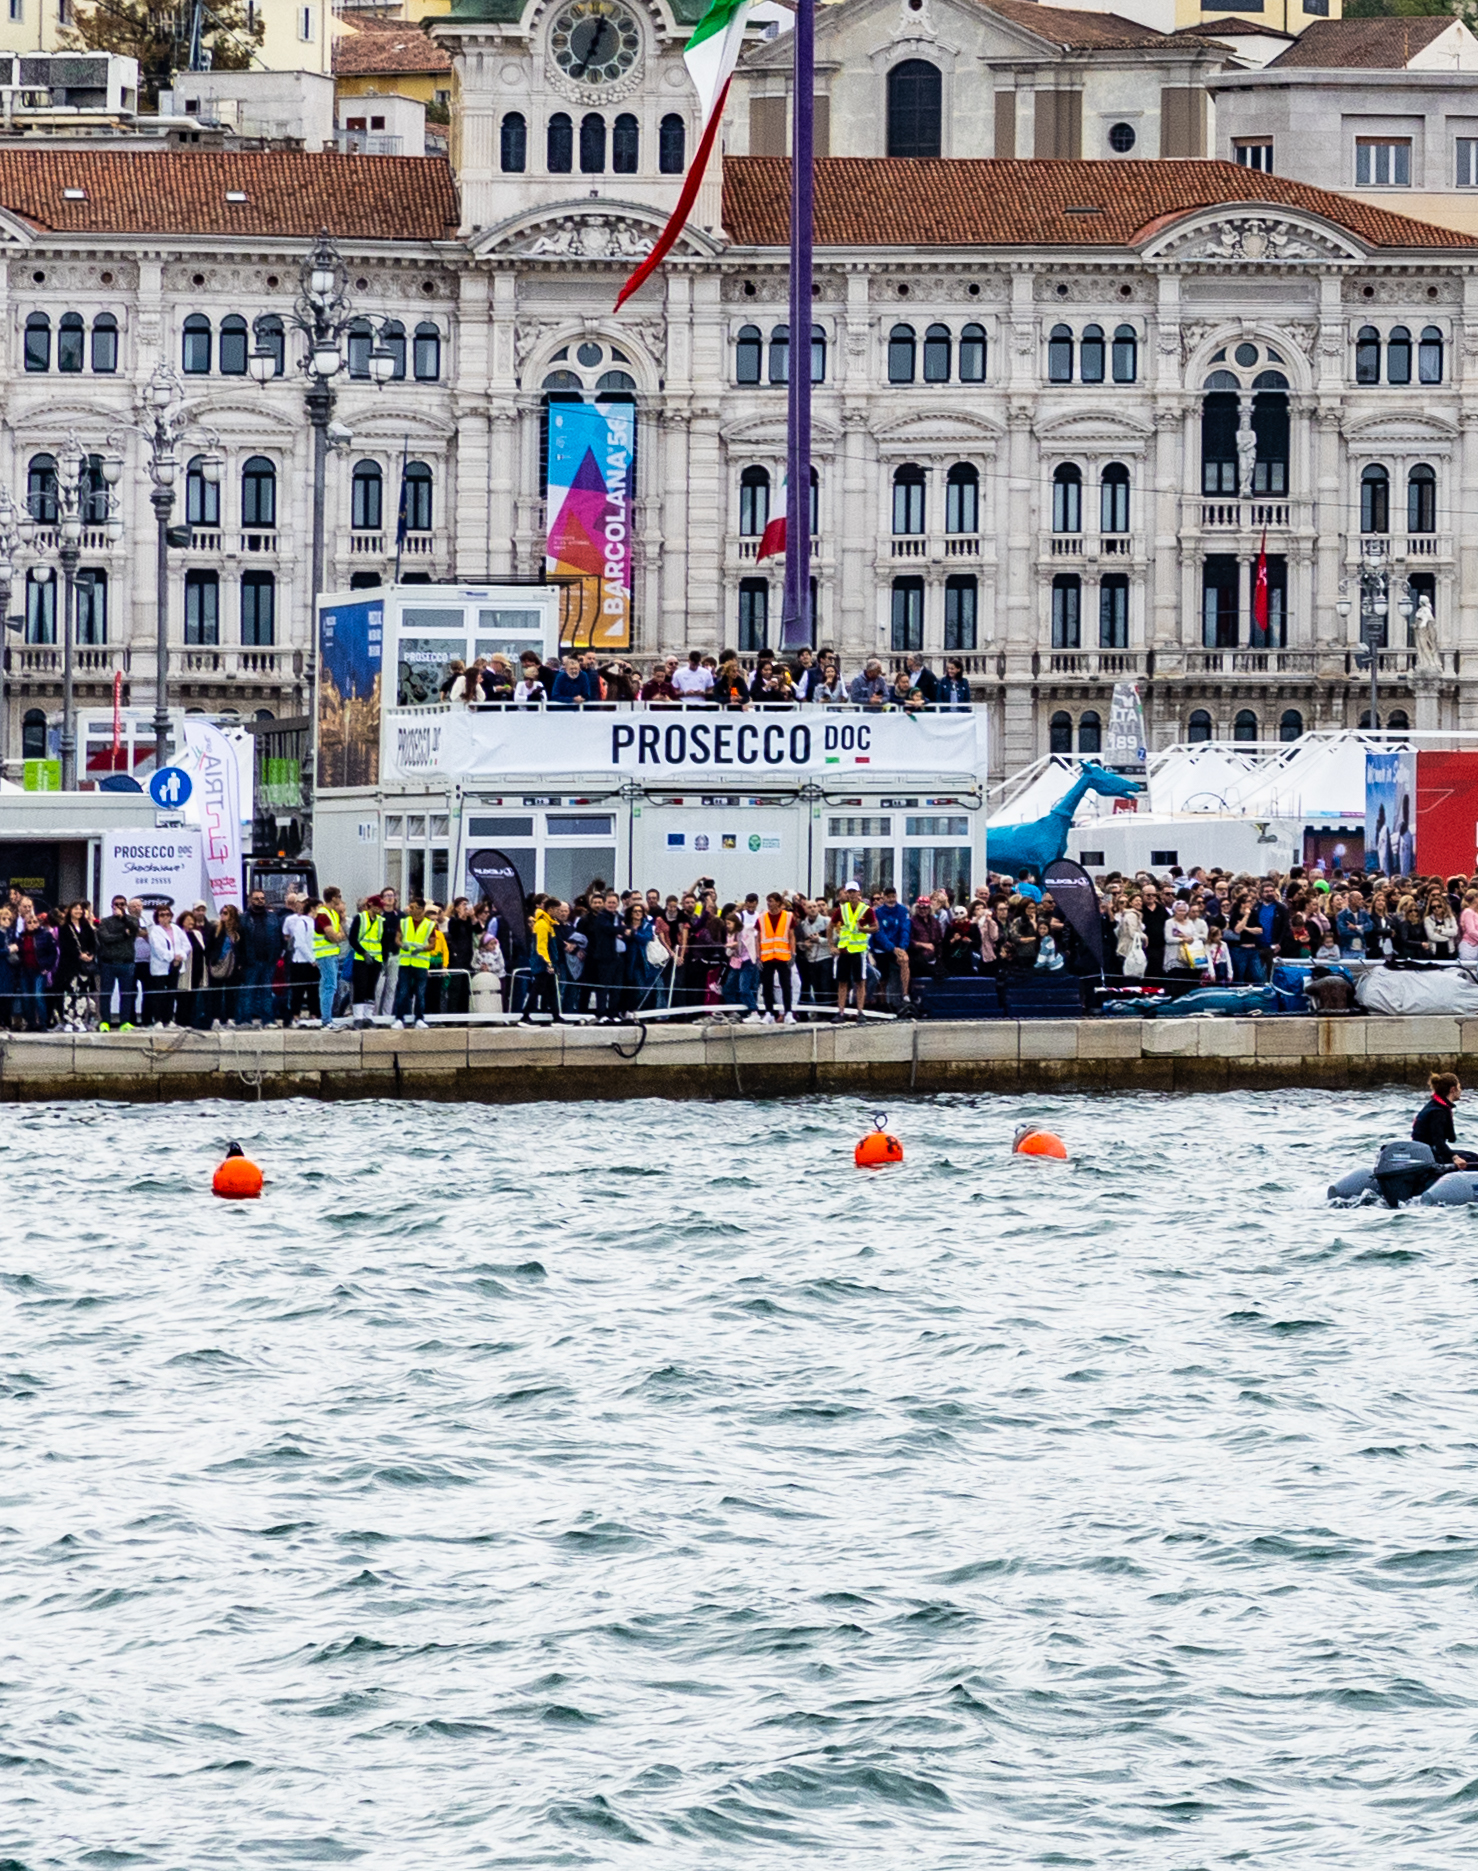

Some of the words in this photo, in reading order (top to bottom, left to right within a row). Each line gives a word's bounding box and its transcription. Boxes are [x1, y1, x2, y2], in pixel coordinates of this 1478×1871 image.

[603, 451, 627, 616] BARCOLANA
[404, 652, 448, 662] PROSECCO
[1112, 708, 1139, 723] ITA
[612, 724, 811, 764] PROSECCO
[825, 725, 871, 750] DOC
[114, 845, 175, 858] PROSECCO
[178, 846, 193, 855] DOC
